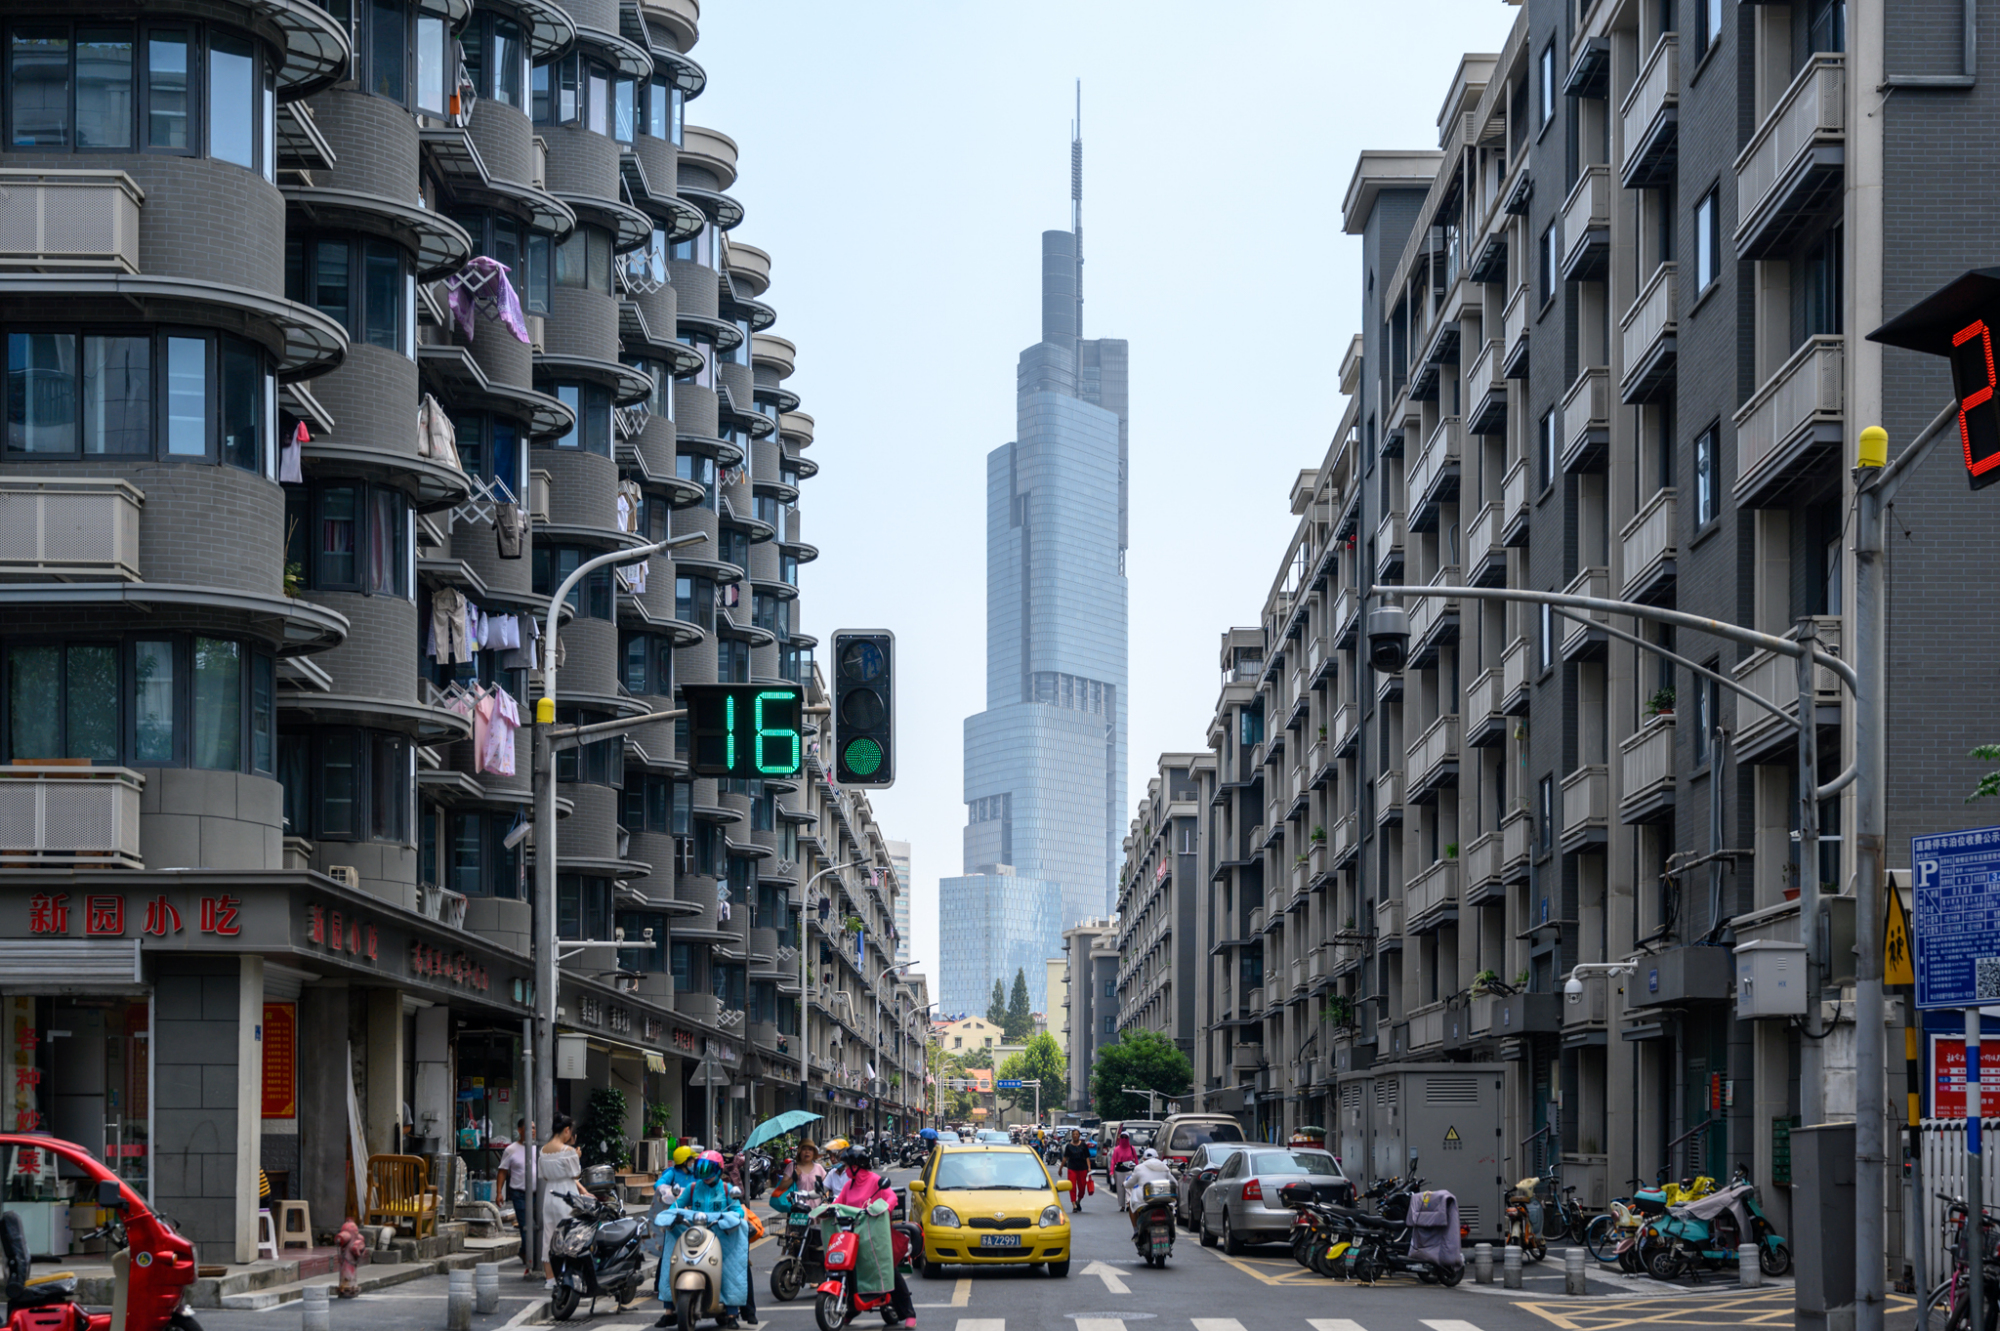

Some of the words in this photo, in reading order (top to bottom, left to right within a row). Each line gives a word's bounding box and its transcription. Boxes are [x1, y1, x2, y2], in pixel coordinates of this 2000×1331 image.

[726, 691, 800, 774] 16
[1918, 860, 1938, 887] P
[28, 892, 241, 936] 新园小吃
[311, 903, 378, 960] 新园小吃
[16, 1026, 41, 1174] 各种炒菜
